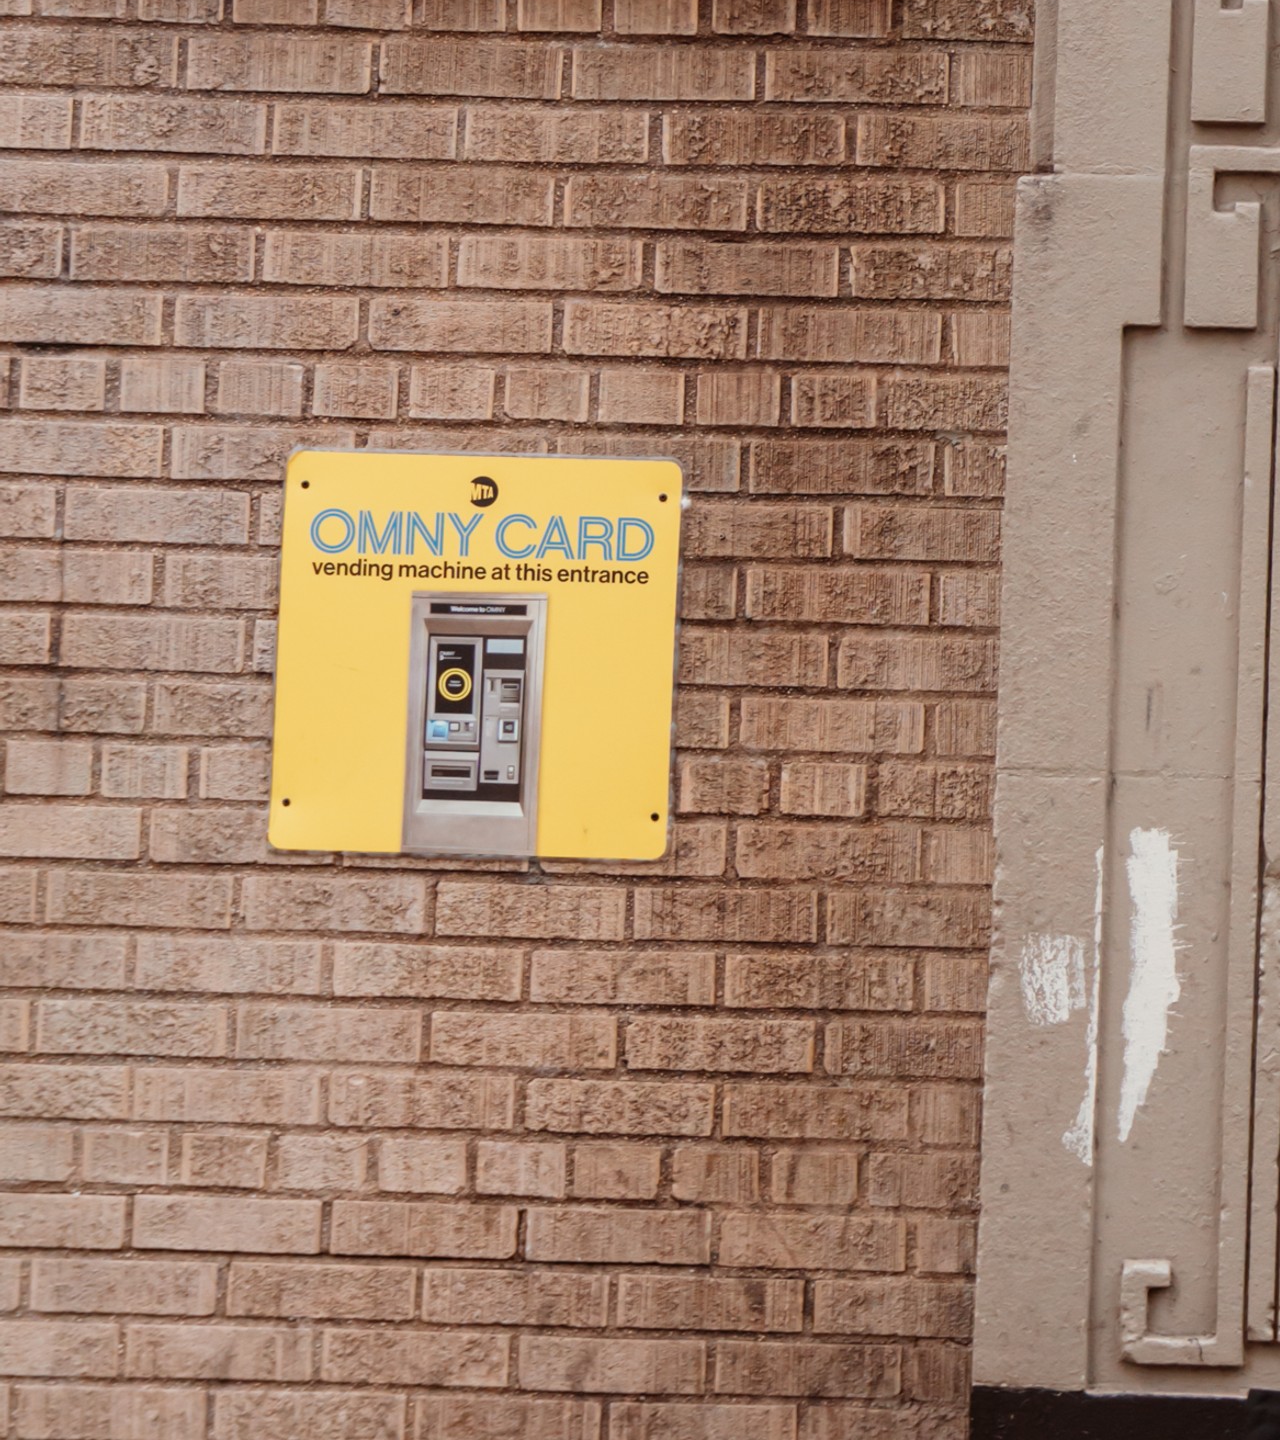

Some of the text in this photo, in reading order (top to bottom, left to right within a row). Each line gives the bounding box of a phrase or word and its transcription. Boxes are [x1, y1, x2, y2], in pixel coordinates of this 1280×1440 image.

[470, 480, 497, 503] MTA
[310, 508, 655, 563] OMNY CARD
[311, 557, 650, 586] vending machine at this entrance
